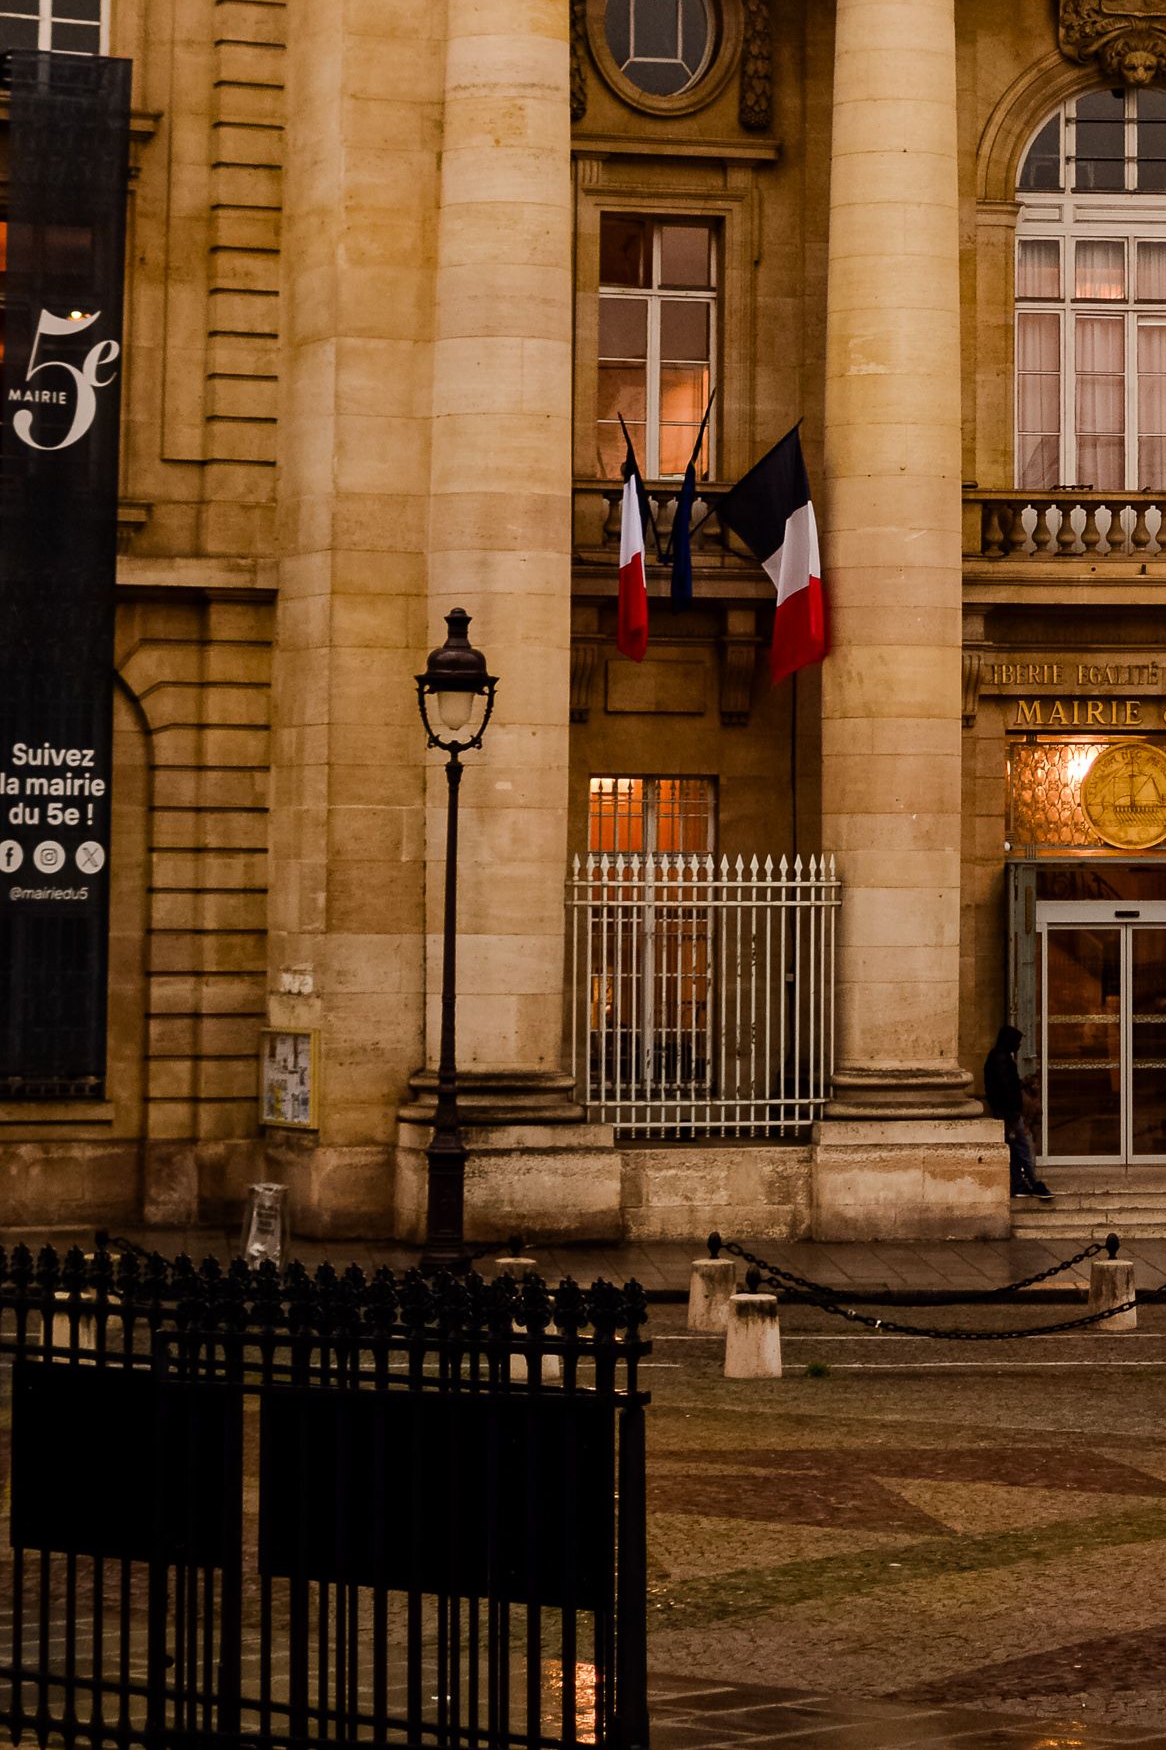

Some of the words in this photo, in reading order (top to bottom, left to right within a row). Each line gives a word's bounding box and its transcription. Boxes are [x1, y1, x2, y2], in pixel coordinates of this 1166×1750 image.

[8, 389, 67, 405] MAIRIE
[1013, 700, 1143, 725] MAIRIE
[12, 742, 95, 767] Suivez
[0, 772, 19, 795] la
[26, 772, 105, 796] mairie
[9, 802, 39, 825] du
[47, 803, 80, 825] 5e
[10, 886, 88, 901] @mairiedu5
